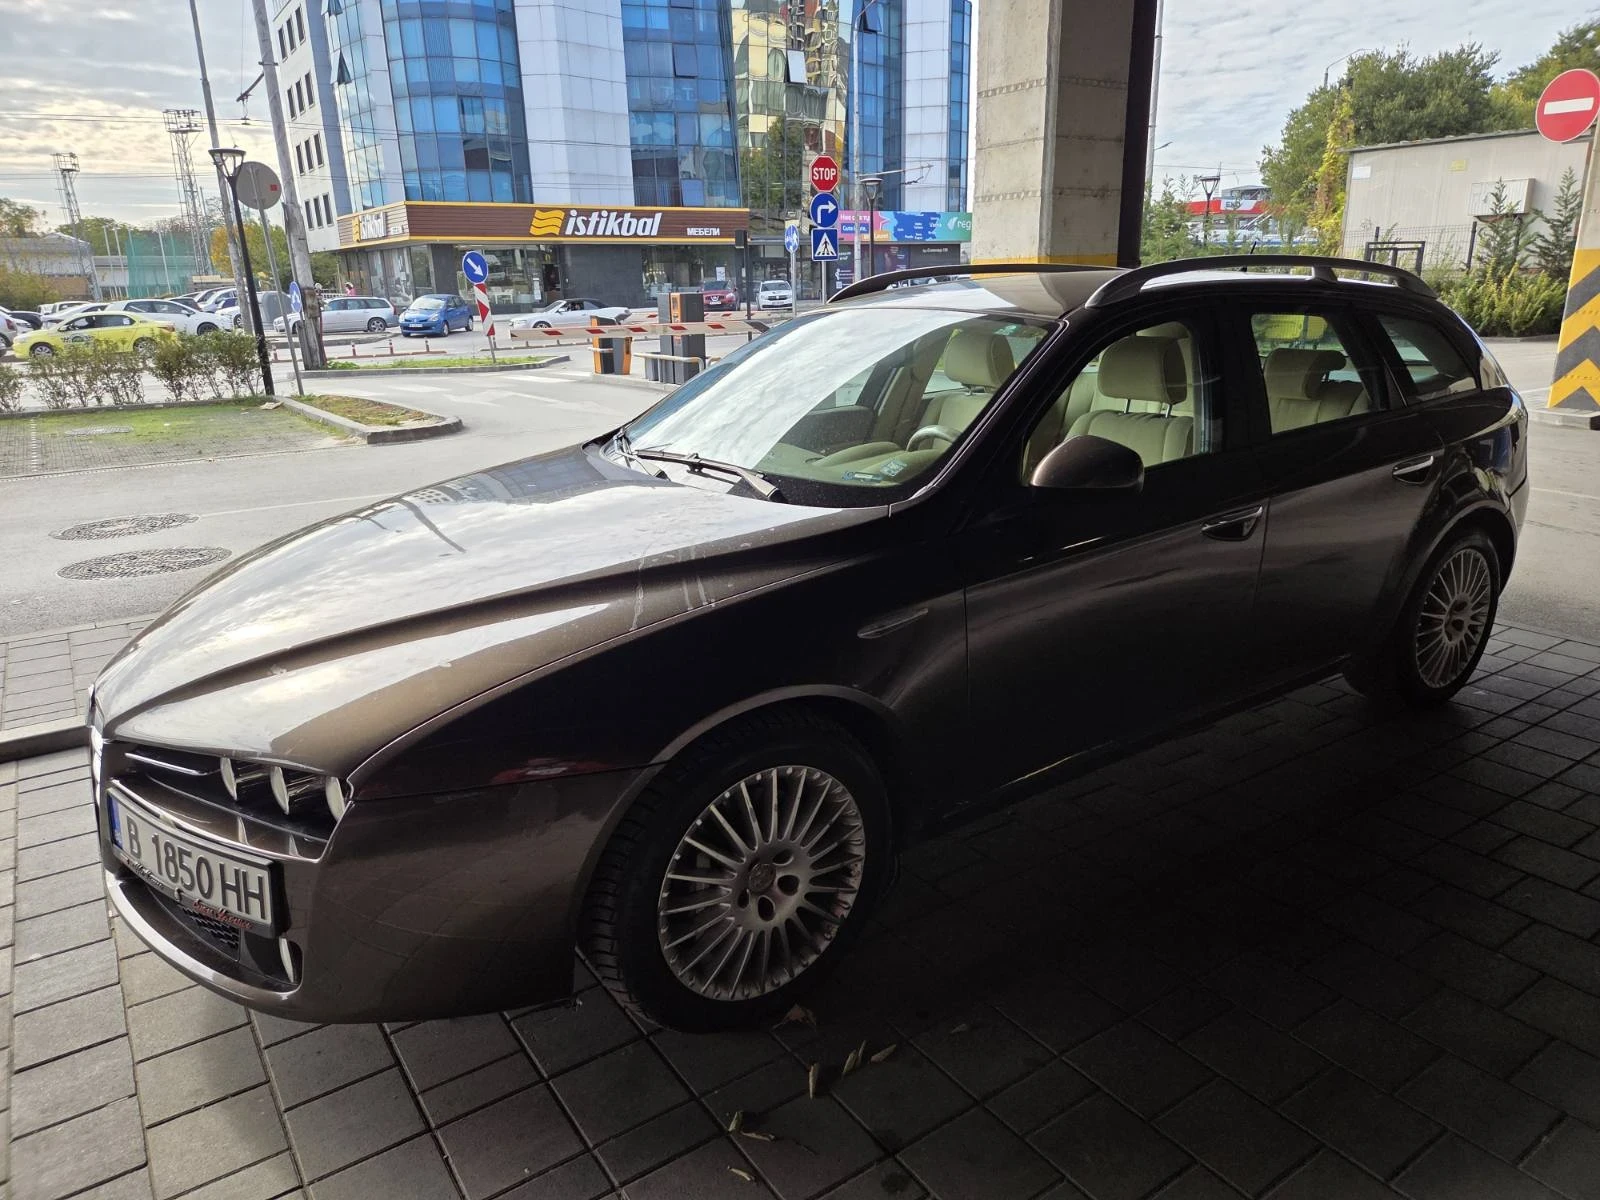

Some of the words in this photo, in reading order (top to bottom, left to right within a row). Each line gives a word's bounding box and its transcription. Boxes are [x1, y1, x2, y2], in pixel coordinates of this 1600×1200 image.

[813, 167, 836, 180] STOP
[565, 209, 662, 237] istikbal
[686, 227, 720, 236] МЕБЕЛИ
[126, 815, 142, 860] B
[151, 833, 214, 900] 1850
[219, 863, 266, 920] HH
